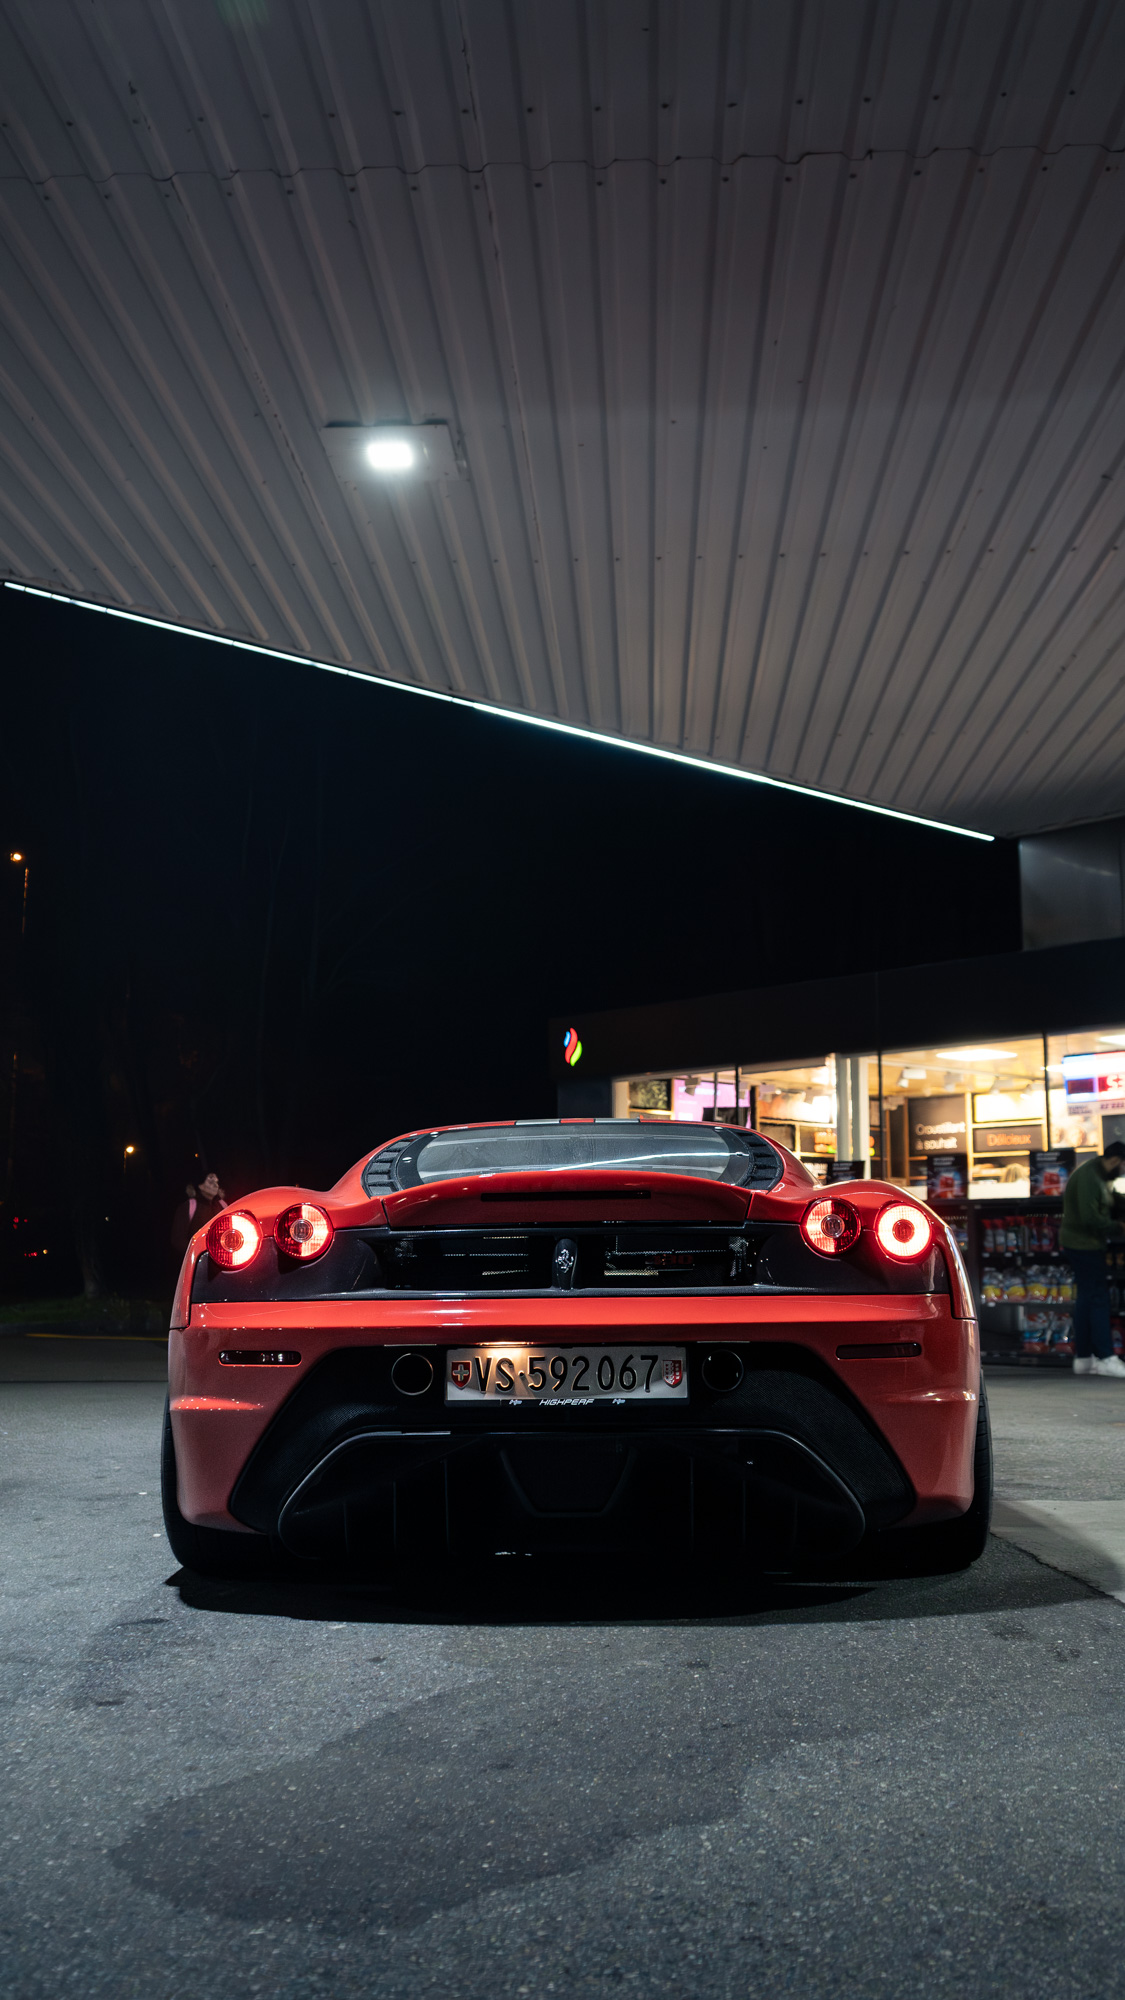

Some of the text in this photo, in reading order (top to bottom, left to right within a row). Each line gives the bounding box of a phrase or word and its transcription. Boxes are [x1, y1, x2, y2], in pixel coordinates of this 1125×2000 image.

[915, 1121, 966, 1136] Croustillant
[924, 1136, 958, 1150] souhait
[539, 1398, 595, 1406] HIGHPERF
